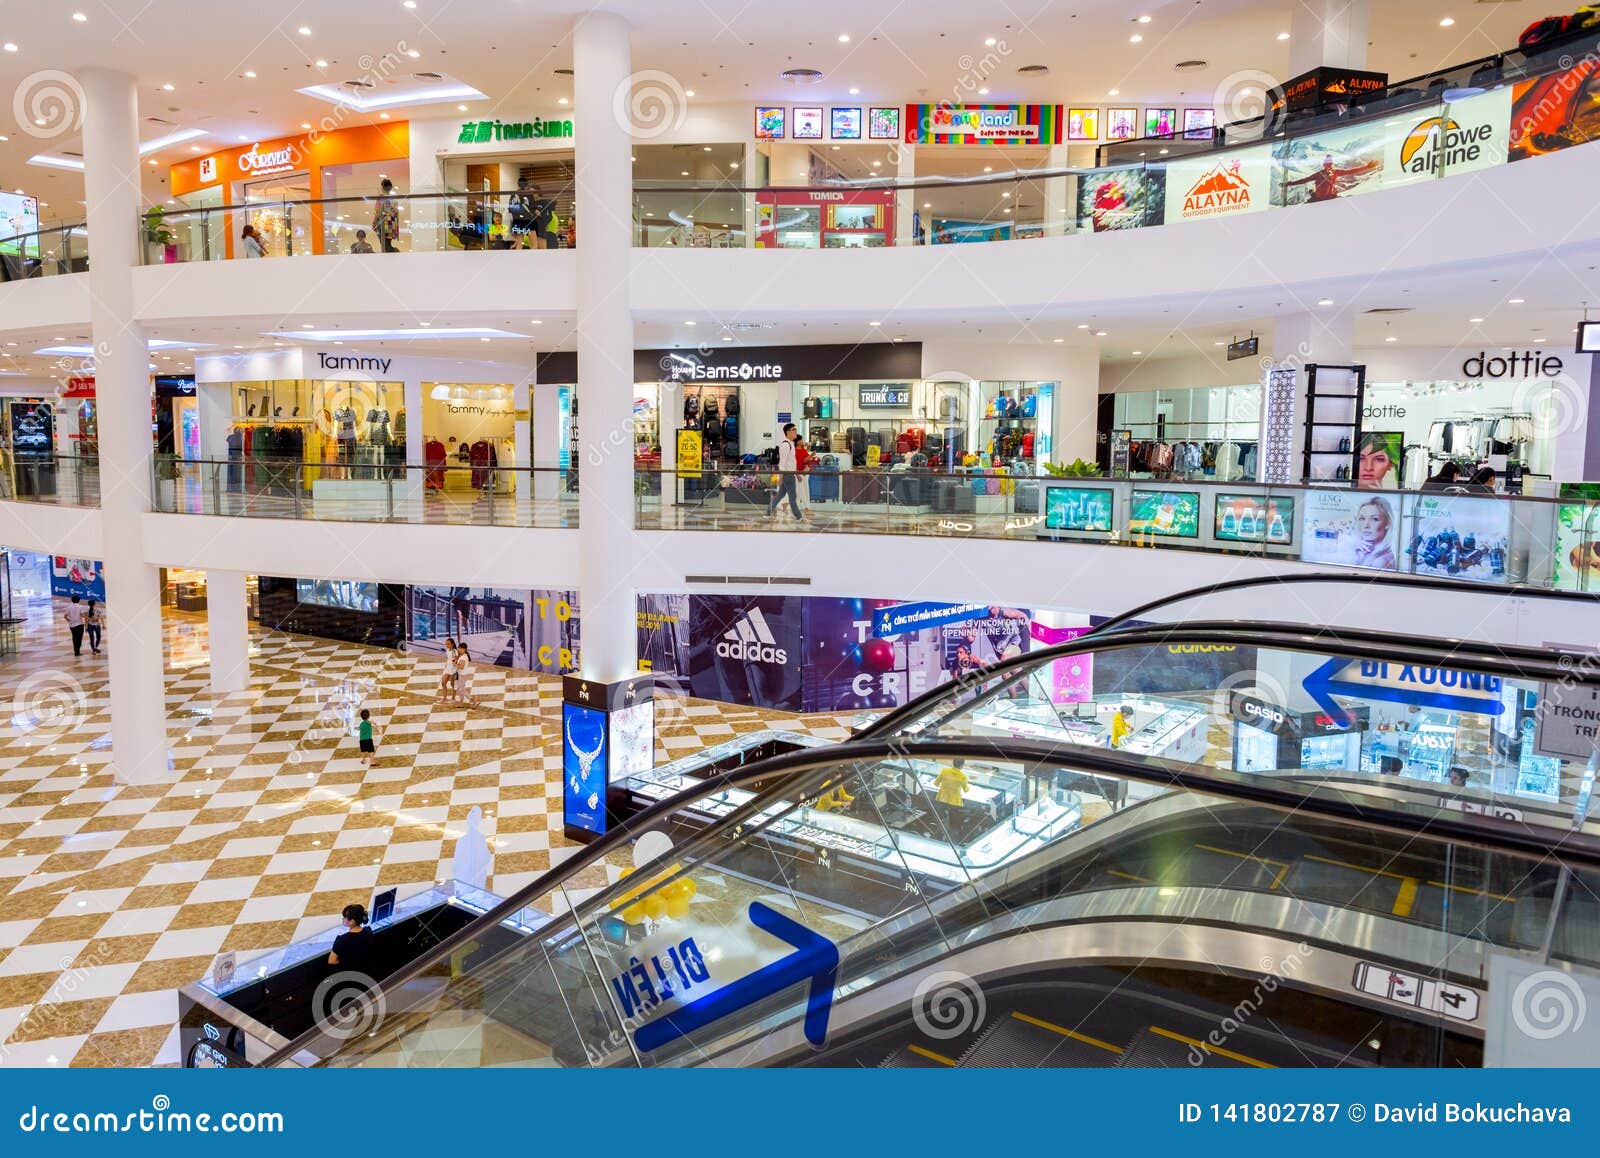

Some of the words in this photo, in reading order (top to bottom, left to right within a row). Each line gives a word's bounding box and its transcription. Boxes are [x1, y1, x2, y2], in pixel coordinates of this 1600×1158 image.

[1349, 79, 1385, 89] ALAYNA
[1432, 123, 1493, 152] Lowe
[1411, 144, 1481, 175] alpine
[808, 191, 844, 201] TOMICA
[1184, 188, 1251, 211] ALAYNA
[1213, 203, 1251, 214] EQUIPMENT
[317, 352, 392, 374] Tammy
[1462, 351, 1563, 378] dottie
[861, 392, 886, 403] TRUNK
[888, 392, 897, 403] &
[447, 404, 486, 415] Tammy
[1362, 405, 1407, 418] dottie
[536, 599, 571, 622] TO
[942, 628, 977, 637] OPENING
[973, 619, 1003, 627] VINCOM
[716, 639, 788, 665] adidas
[1245, 702, 1283, 723] CASIO
[1440, 990, 1467, 1009] 4
